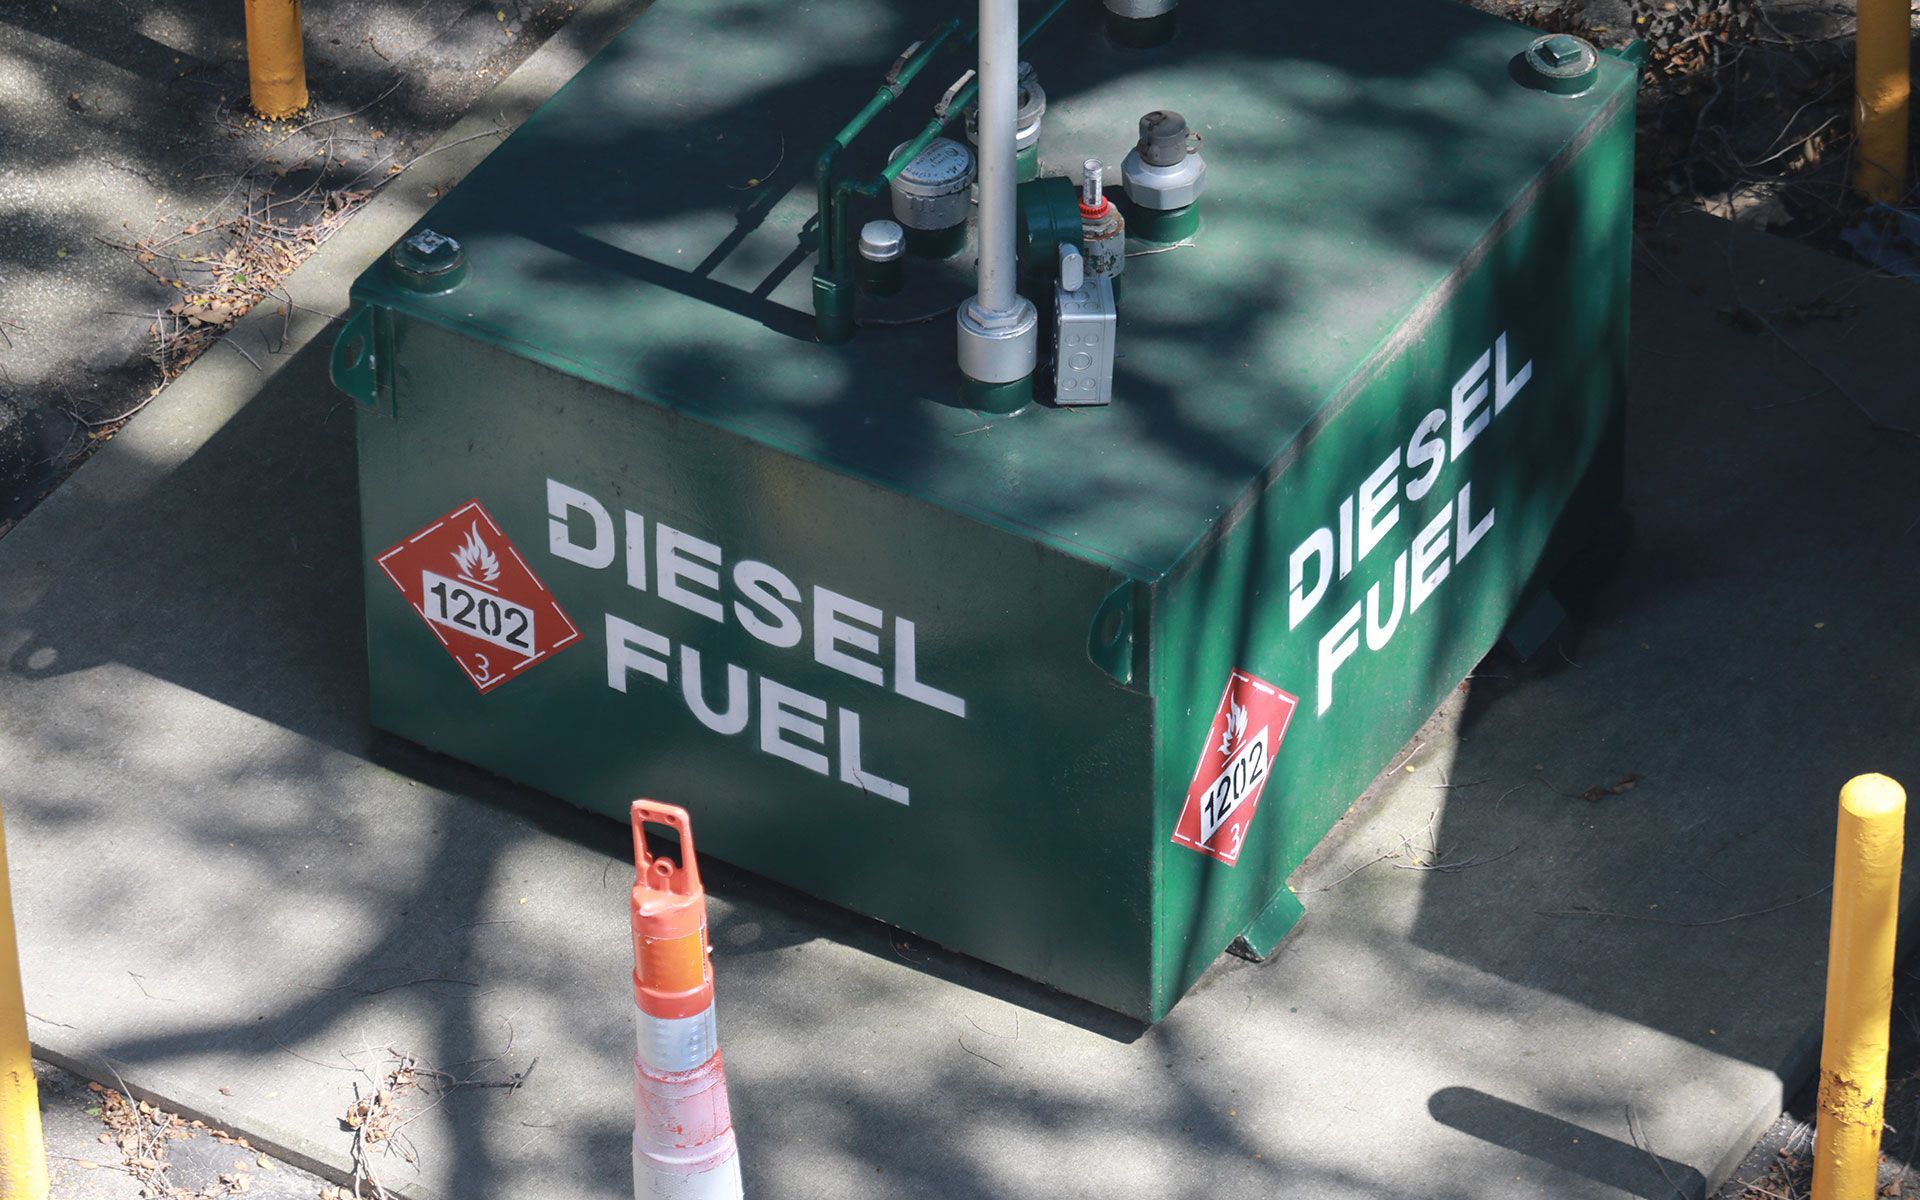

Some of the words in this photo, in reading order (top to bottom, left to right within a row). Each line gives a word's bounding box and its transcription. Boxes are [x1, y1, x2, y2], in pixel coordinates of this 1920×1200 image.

[1289, 330, 1533, 632] DIESEL
[430, 581, 529, 649] 1202
[474, 652, 490, 682] 3
[547, 478, 966, 718] DIESEL
[1317, 481, 1495, 718] FUEL
[605, 613, 910, 806] FUEL
[1204, 741, 1264, 828] 1202
[1230, 822, 1241, 855] 3
